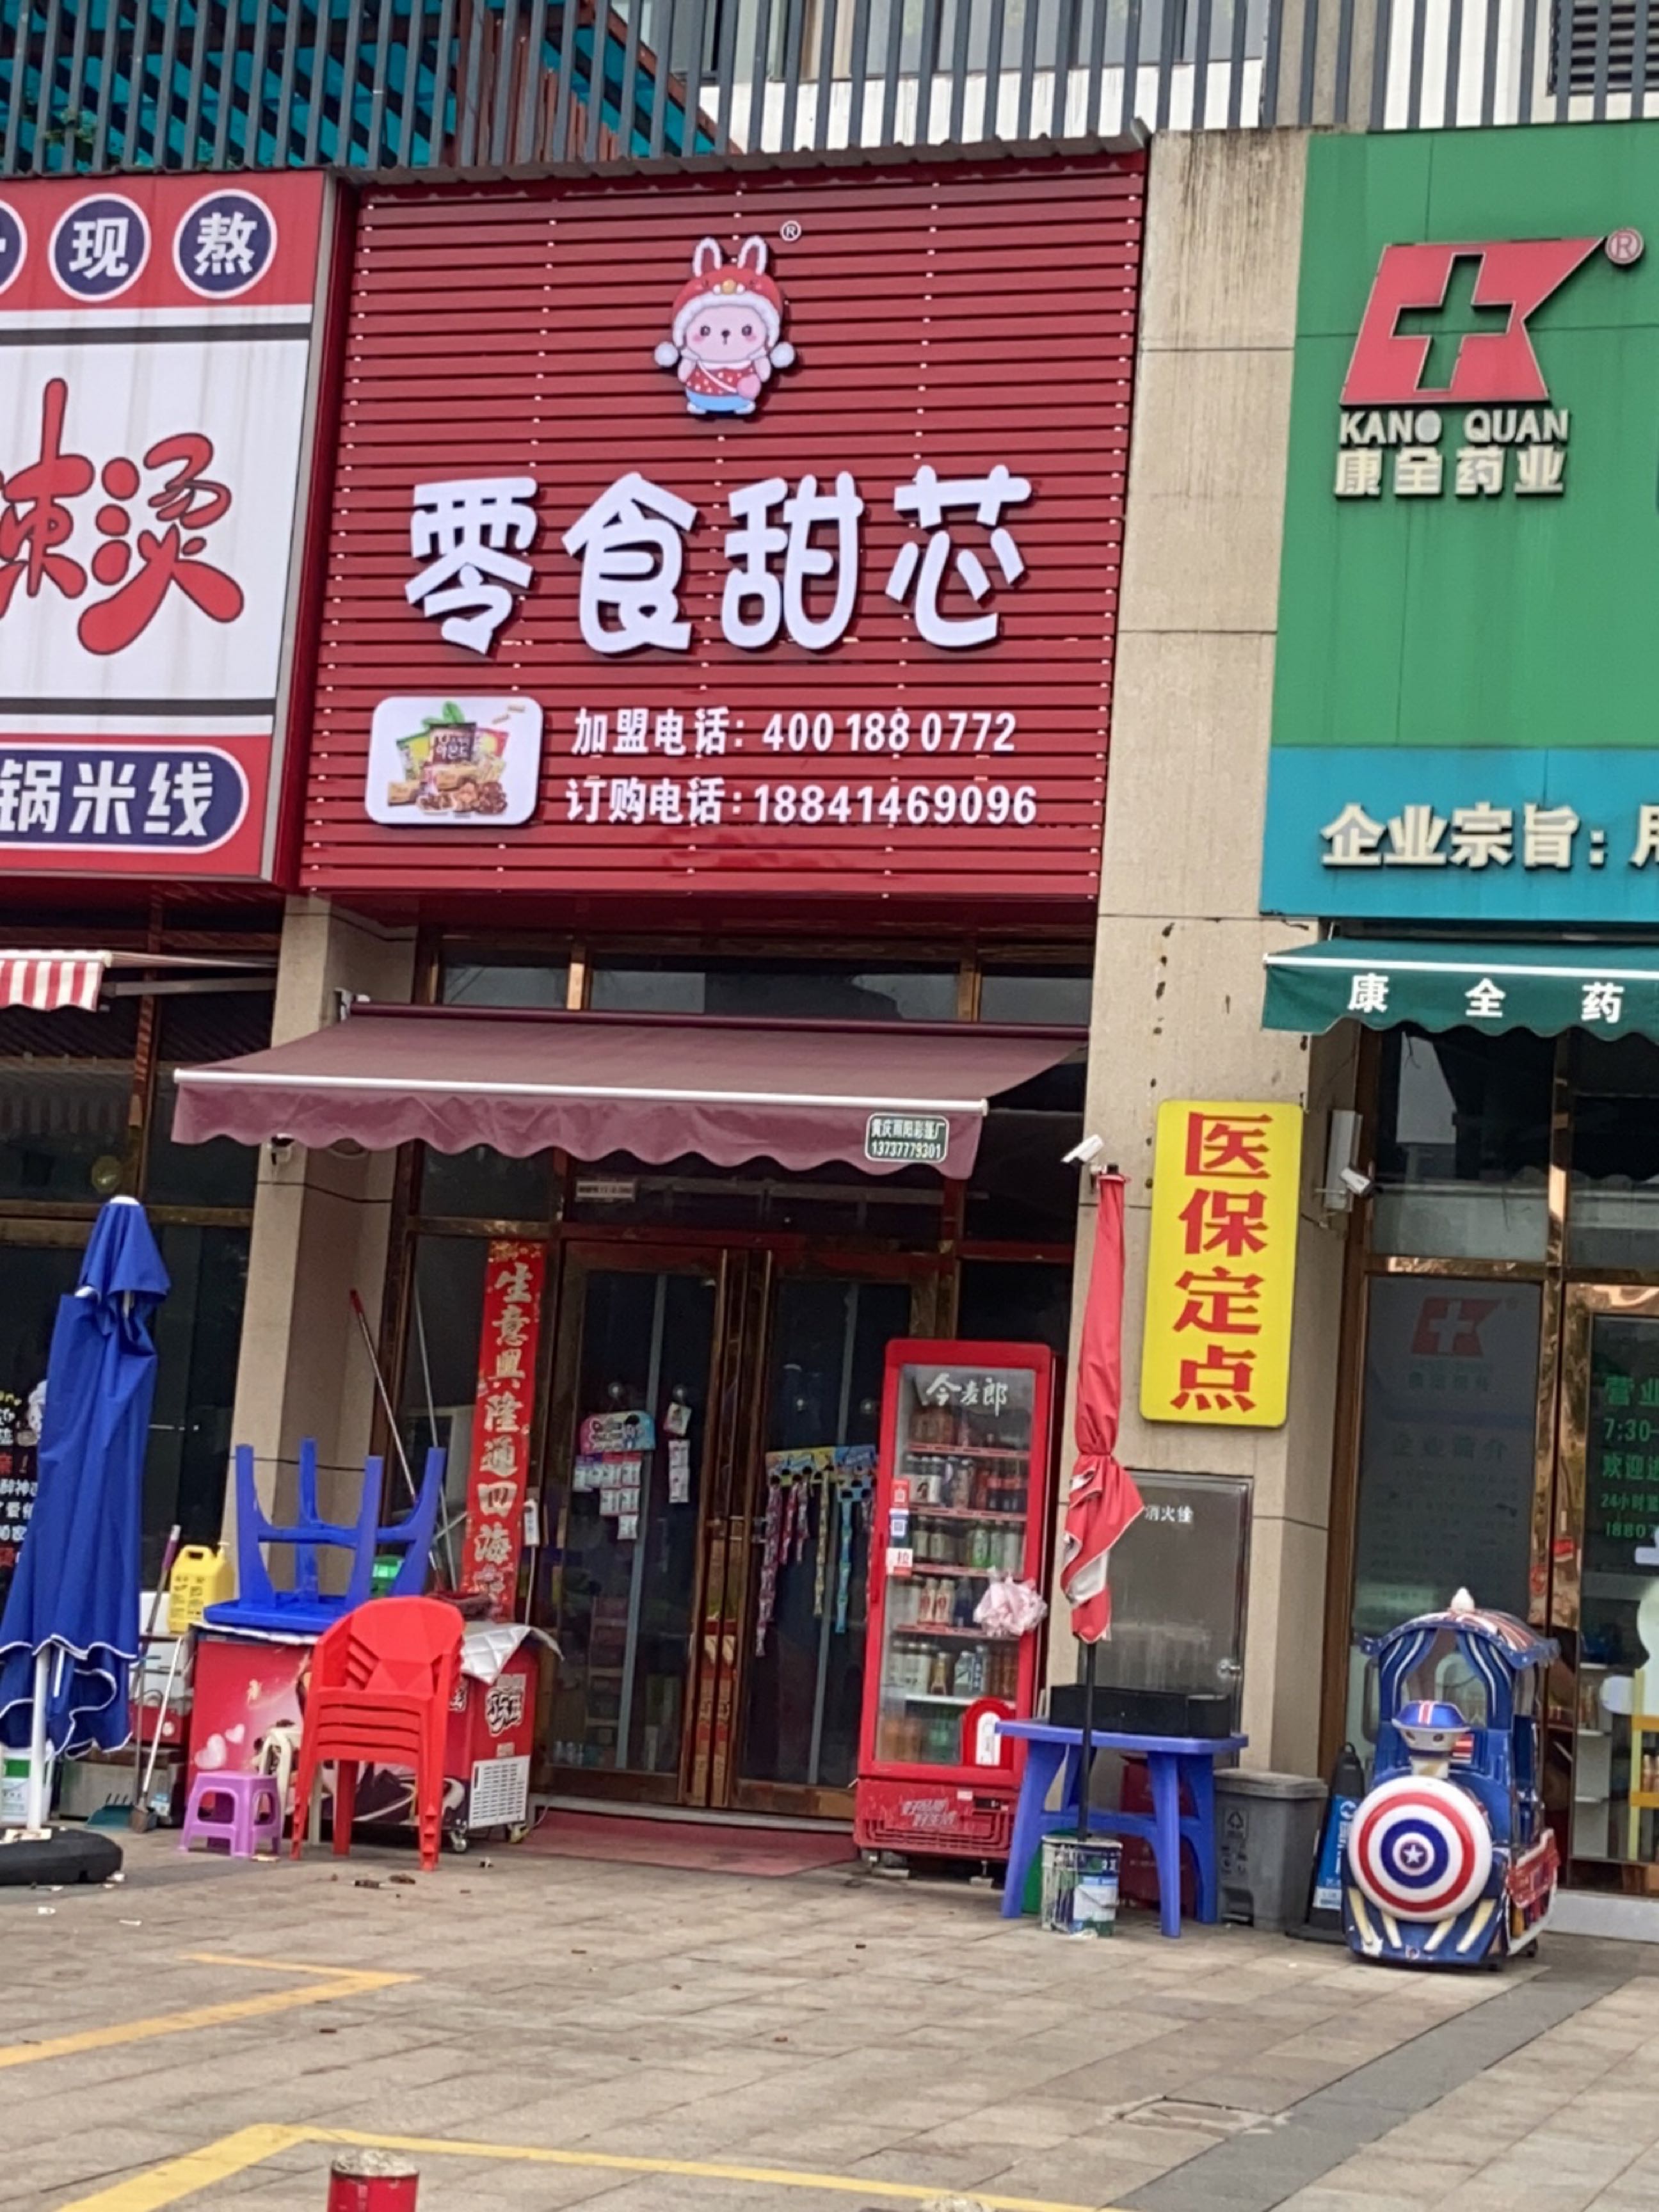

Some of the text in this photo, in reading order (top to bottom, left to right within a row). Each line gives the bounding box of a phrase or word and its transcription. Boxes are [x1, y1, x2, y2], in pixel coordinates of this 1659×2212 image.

[1464, 409, 1568, 443] QUAN
[1334, 445, 1565, 495] 康全药业
[405, 465, 1032, 654] 零食甜芯
[571, 707, 1016, 755] 加盟电话： 400 188 0772
[0, 760, 213, 836] 锅米线
[566, 778, 1037, 824] 订购电话： 18841469096
[1348, 973, 1624, 1023] 康全药
[1170, 1111, 1273, 1412] 医保定点
[926, 1373, 1007, 1417] 今麦郎
